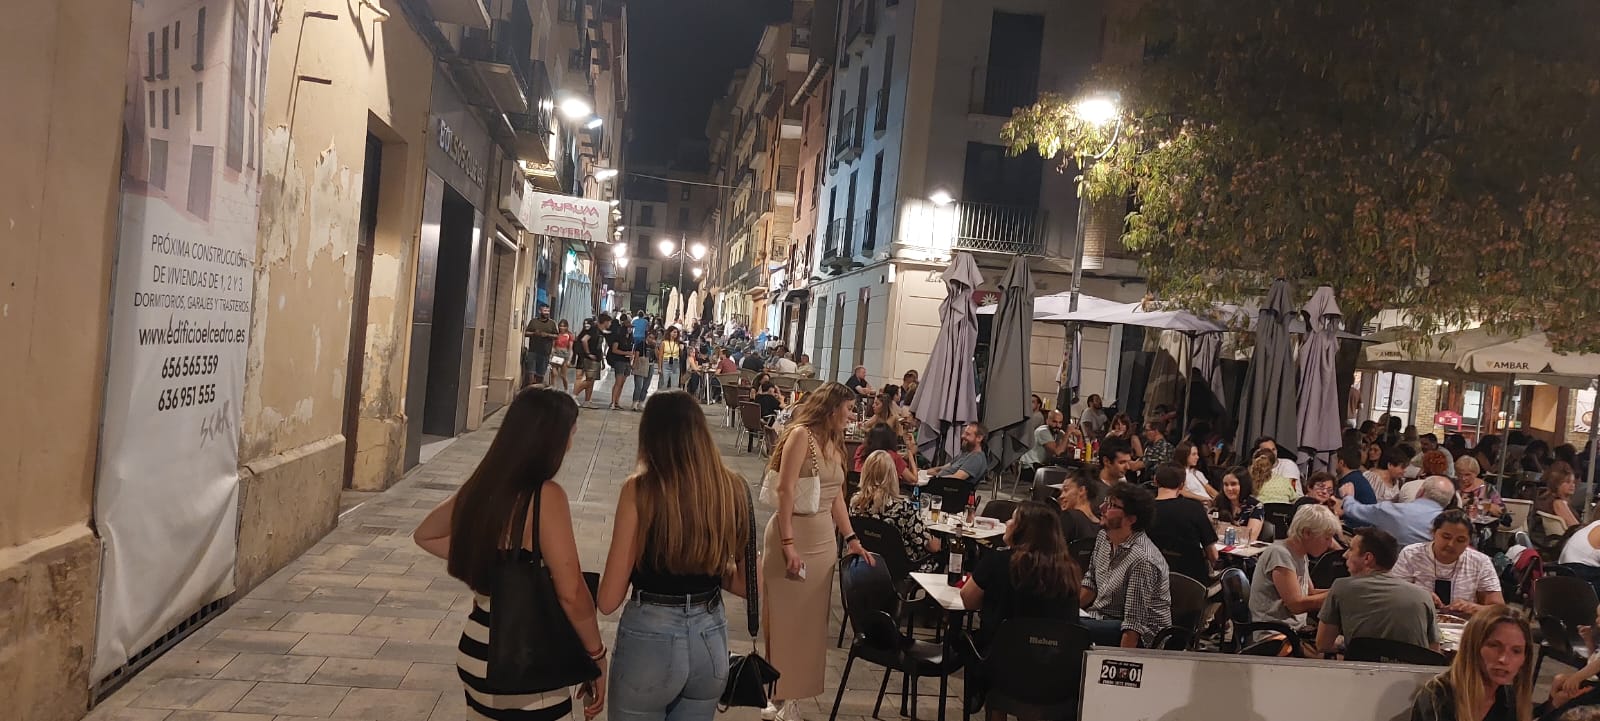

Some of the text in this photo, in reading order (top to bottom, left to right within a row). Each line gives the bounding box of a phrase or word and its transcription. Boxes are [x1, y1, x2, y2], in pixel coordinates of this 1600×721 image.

[151, 232, 247, 268] PRÓXIMA CONSTRUCCIÓN
[153, 265, 166, 284] DE
[167, 266, 208, 288] VIVIENDAS
[208, 272, 219, 289] DE
[227, 275, 232, 291] 2
[233, 276, 238, 292] Y
[238, 277, 243, 292] 3
[134, 292, 186, 311] DORMITORIOS,
[187, 296, 213, 310] GARAJES
[213, 298, 218, 311] Y
[138, 317, 246, 346] www.edificioelcedro.es
[161, 354, 219, 379] 656 565 359
[1493, 361, 1529, 370] AMBAR
[158, 383, 216, 412] 636 951 555
[1101, 664, 1118, 680] 20
